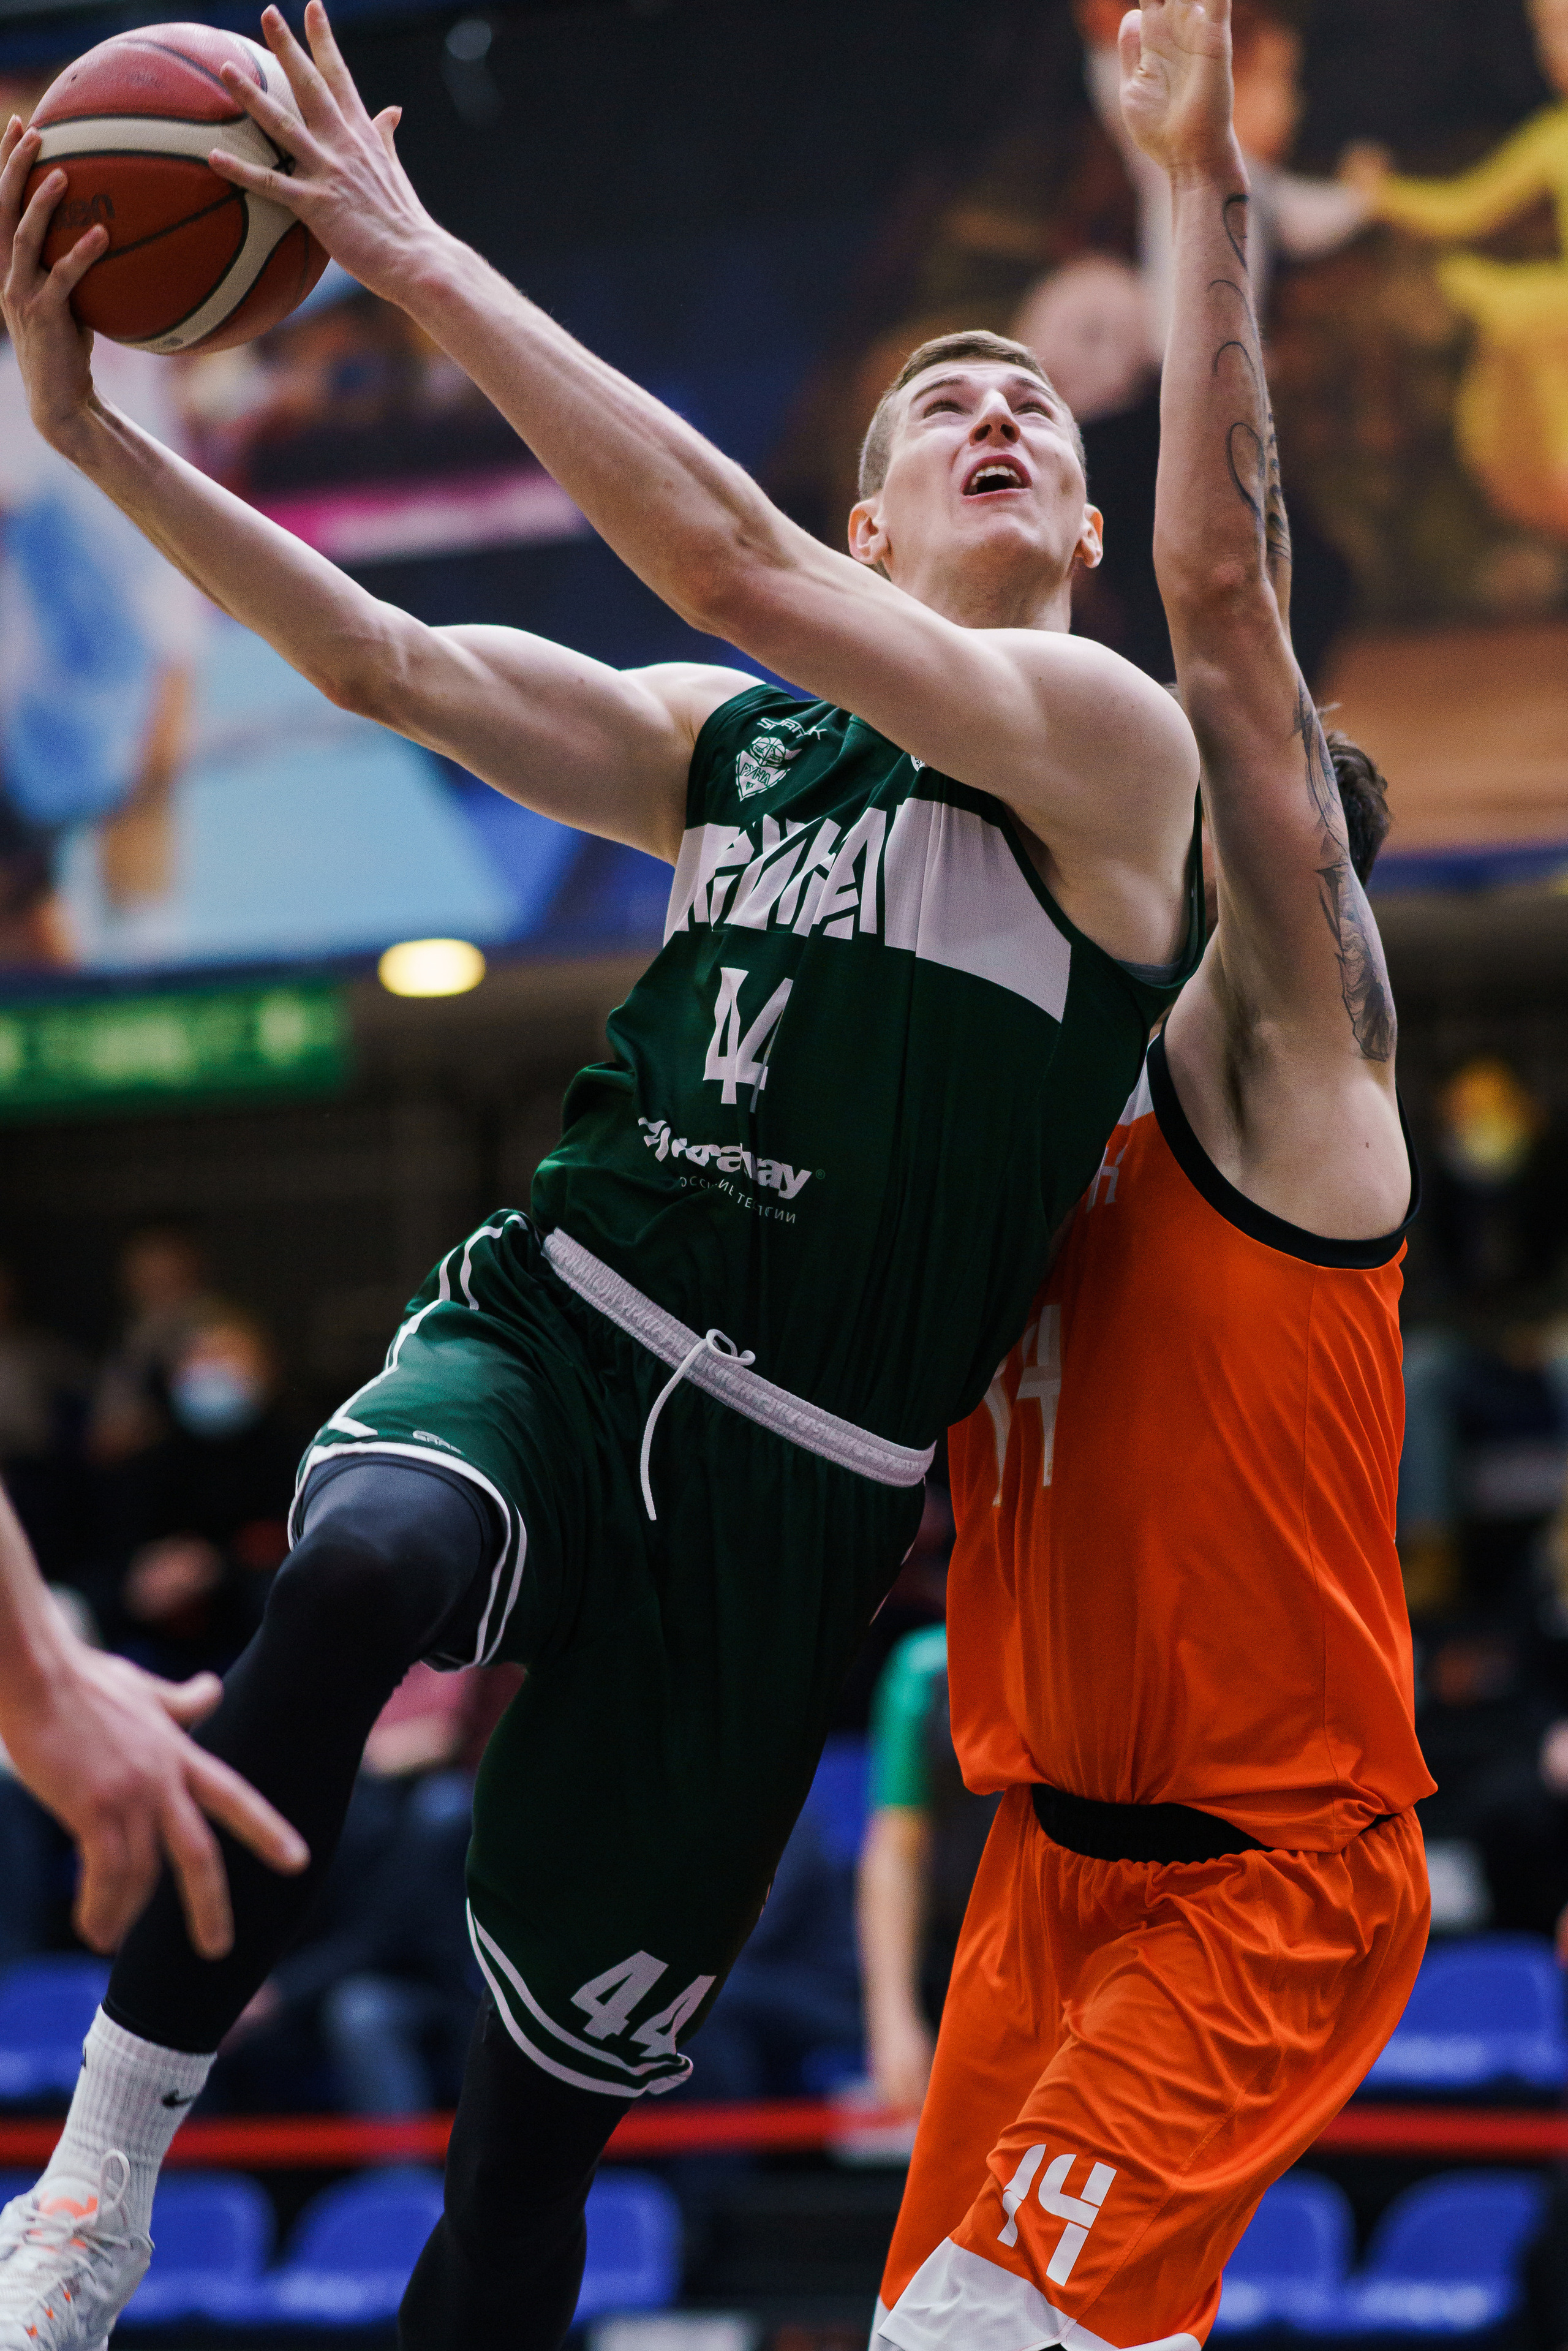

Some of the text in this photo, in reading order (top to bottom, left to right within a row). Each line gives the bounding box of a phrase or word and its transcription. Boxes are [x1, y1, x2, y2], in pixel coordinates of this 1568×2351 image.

[703, 967, 794, 1114] 44
[570, 1950, 717, 2057] 44
[997, 2143, 1117, 2287] 14
